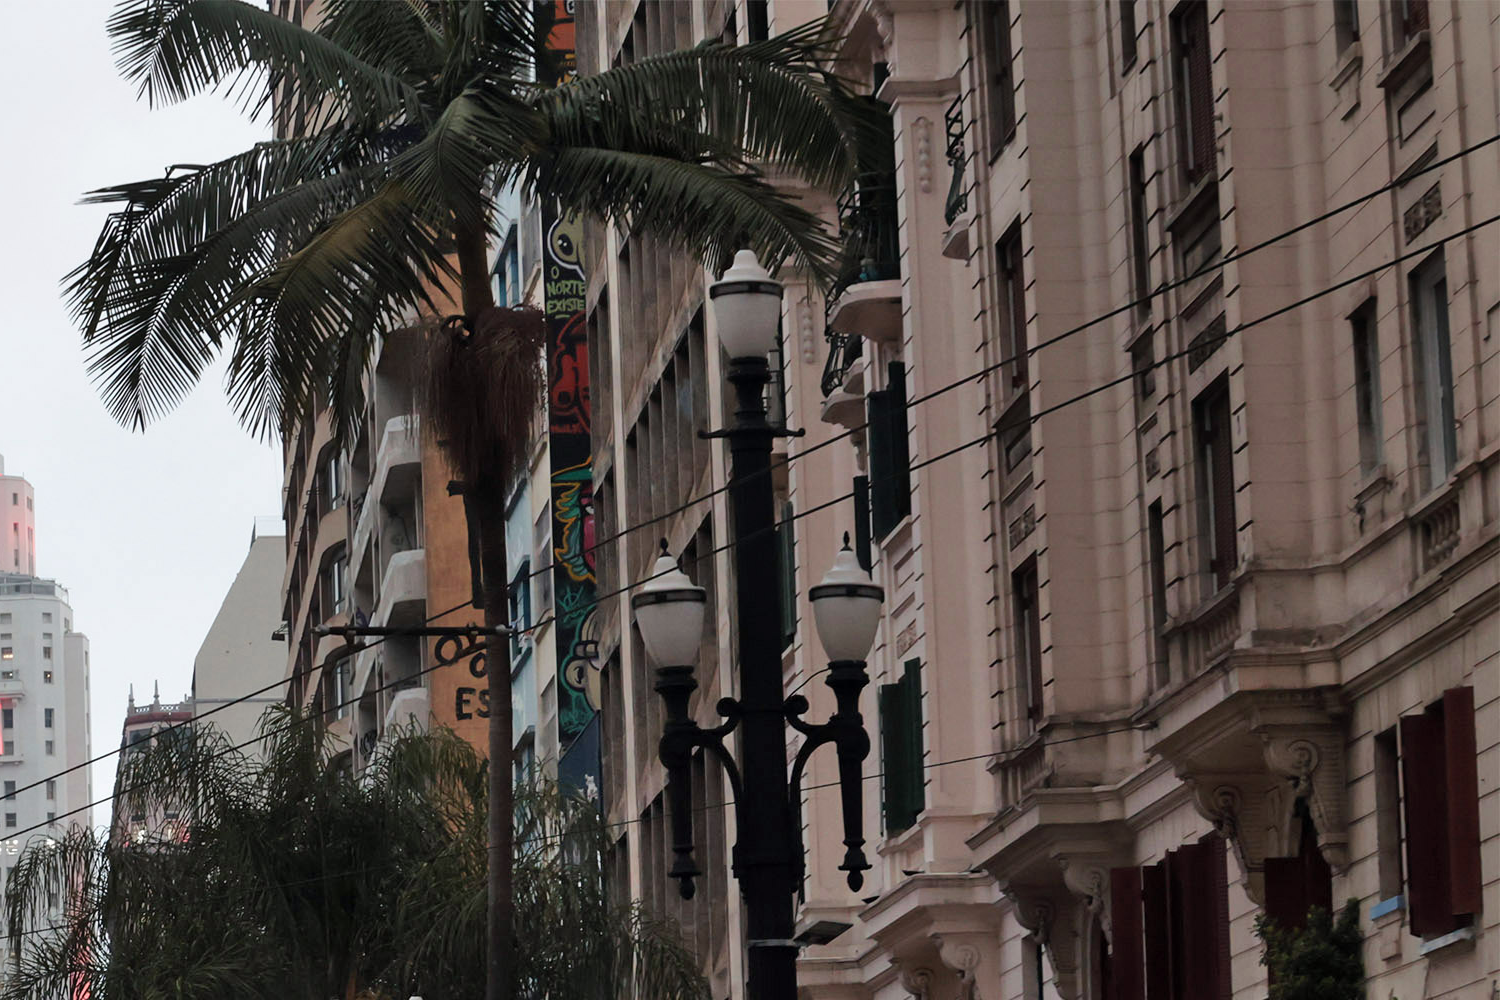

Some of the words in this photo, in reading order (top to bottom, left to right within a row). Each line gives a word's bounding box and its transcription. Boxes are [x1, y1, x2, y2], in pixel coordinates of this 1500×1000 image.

[551, 266, 560, 279] O
[546, 280, 587, 297] NORTE
[546, 299, 585, 314] EXISTE
